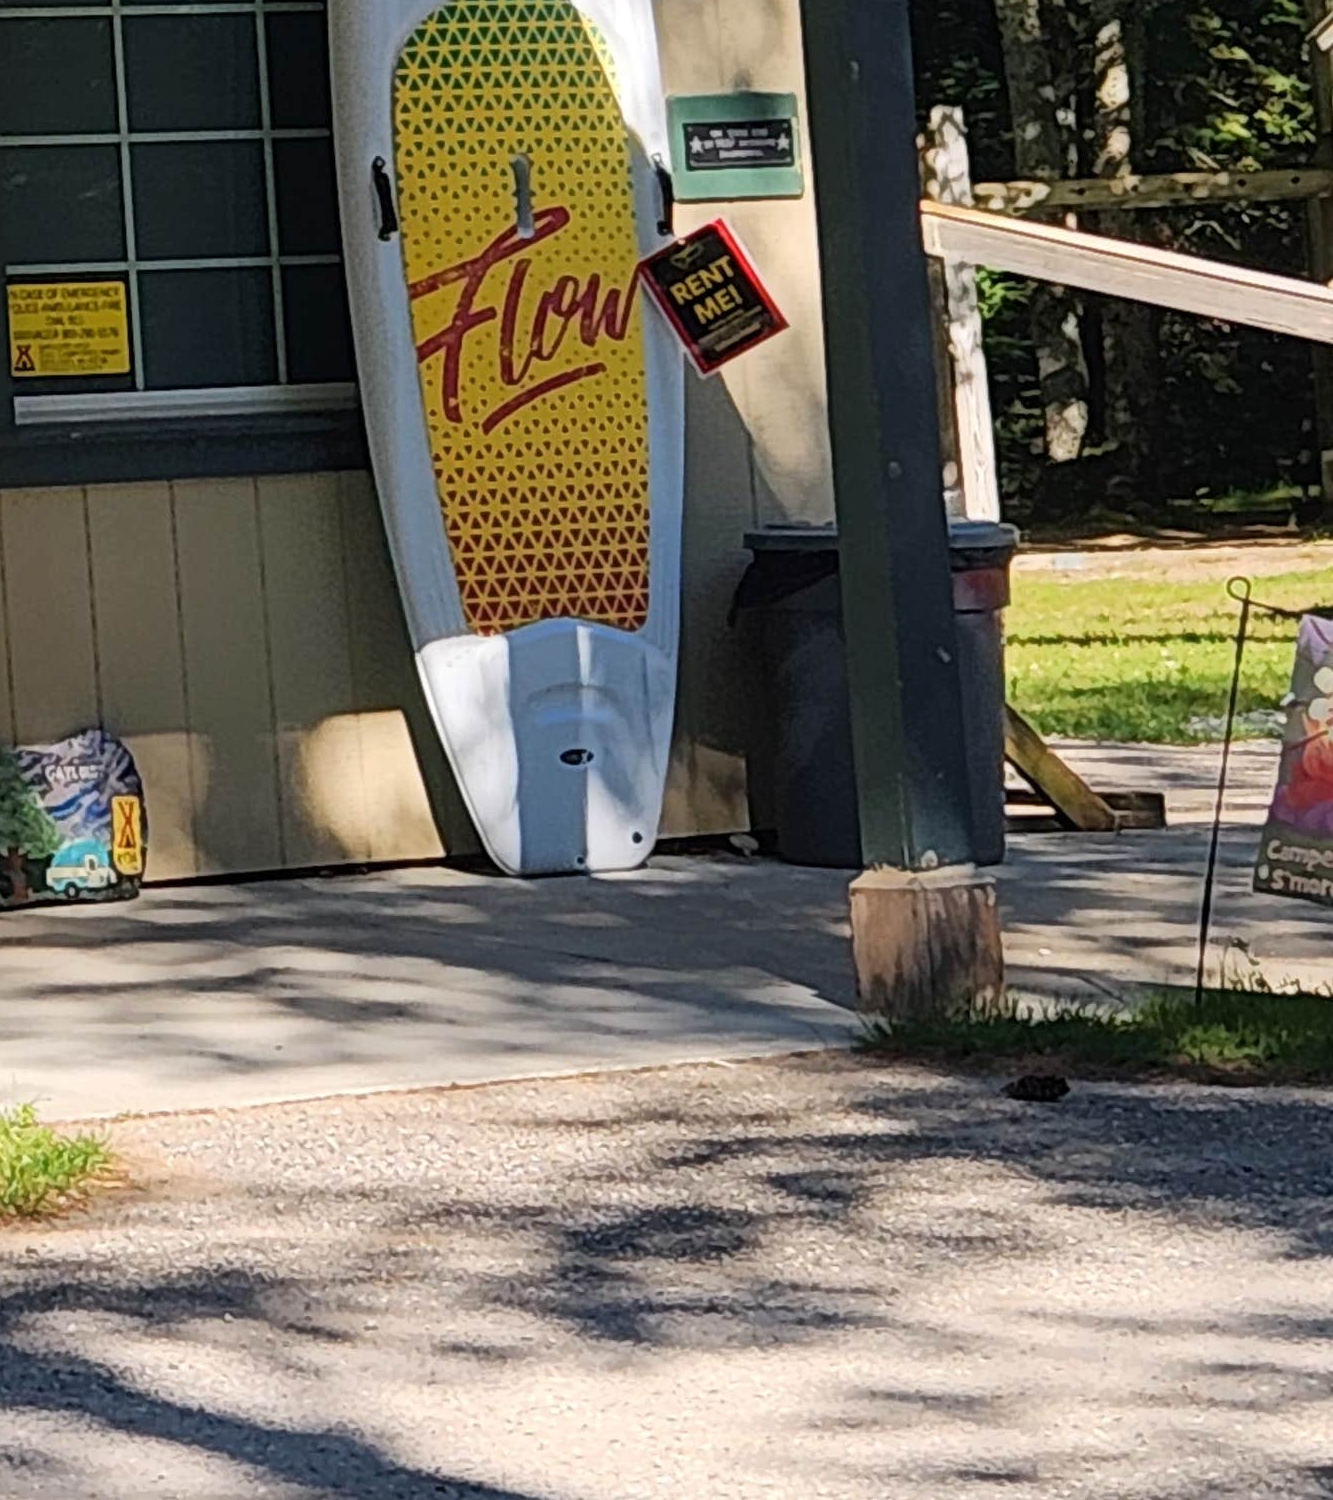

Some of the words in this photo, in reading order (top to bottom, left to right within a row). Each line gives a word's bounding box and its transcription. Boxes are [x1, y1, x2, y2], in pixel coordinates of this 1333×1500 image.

[669, 254, 735, 306] RENT
[409, 206, 639, 424] Flow
[692, 284, 744, 325] ME!
[1270, 868, 1333, 897] S'mor
